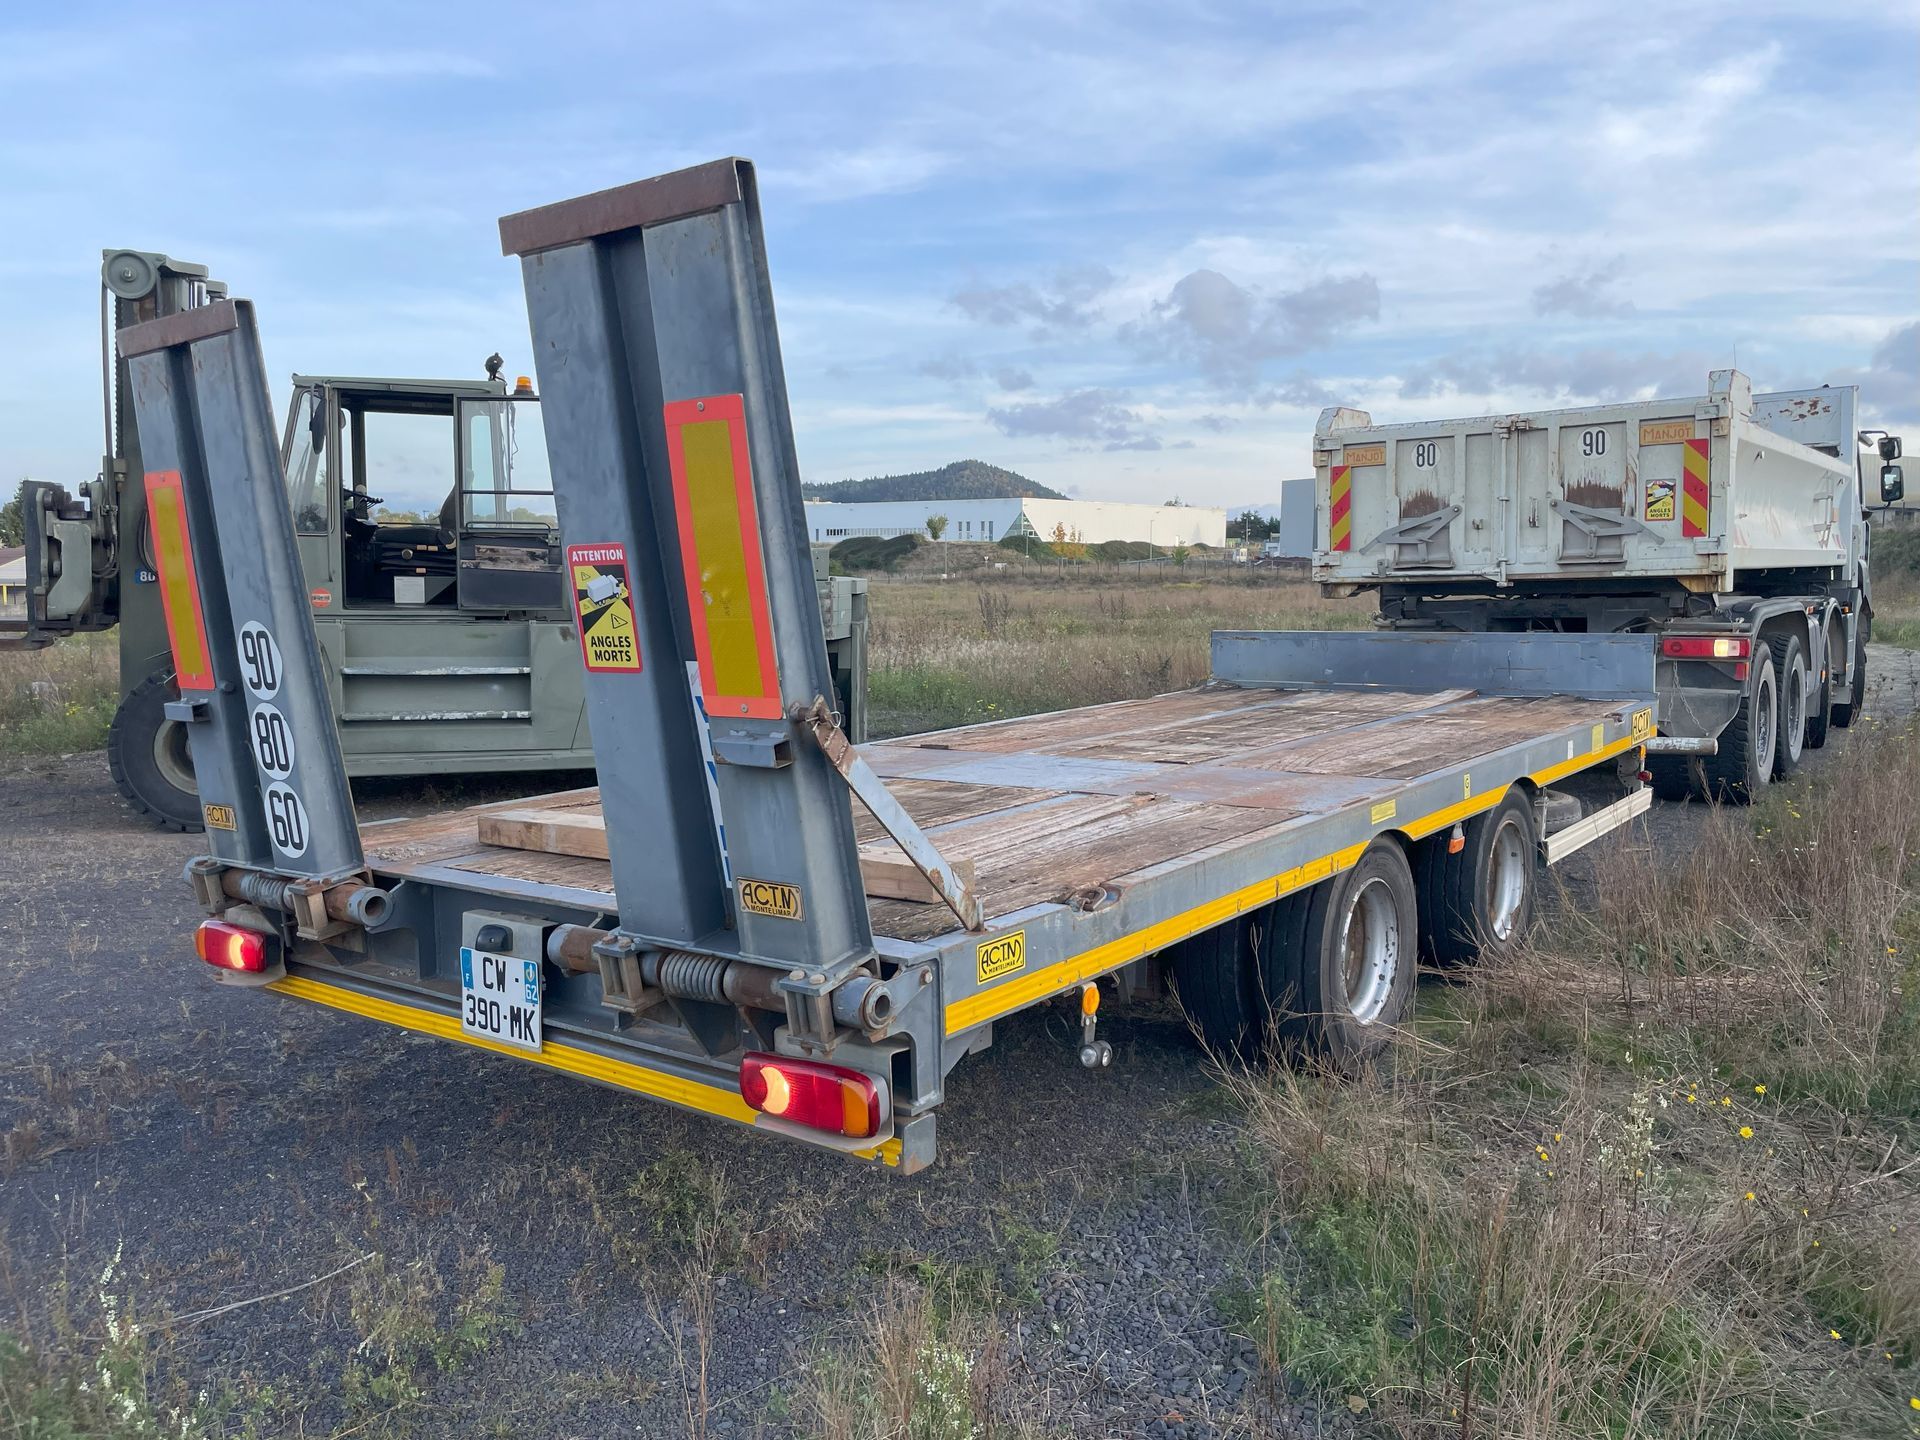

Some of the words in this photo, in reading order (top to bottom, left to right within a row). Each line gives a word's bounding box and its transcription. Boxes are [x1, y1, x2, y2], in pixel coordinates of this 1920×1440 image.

[1583, 430, 1606, 456] 90
[1416, 443, 1436, 467] 80
[572, 549, 623, 562] ATTENTION
[590, 636, 631, 648] ANGLES
[241, 630, 277, 690] 90
[594, 649, 632, 662] MORTS
[255, 711, 290, 772] 80
[268, 789, 304, 850] 60
[466, 973, 470, 982] F
[525, 984, 537, 1001] 62
